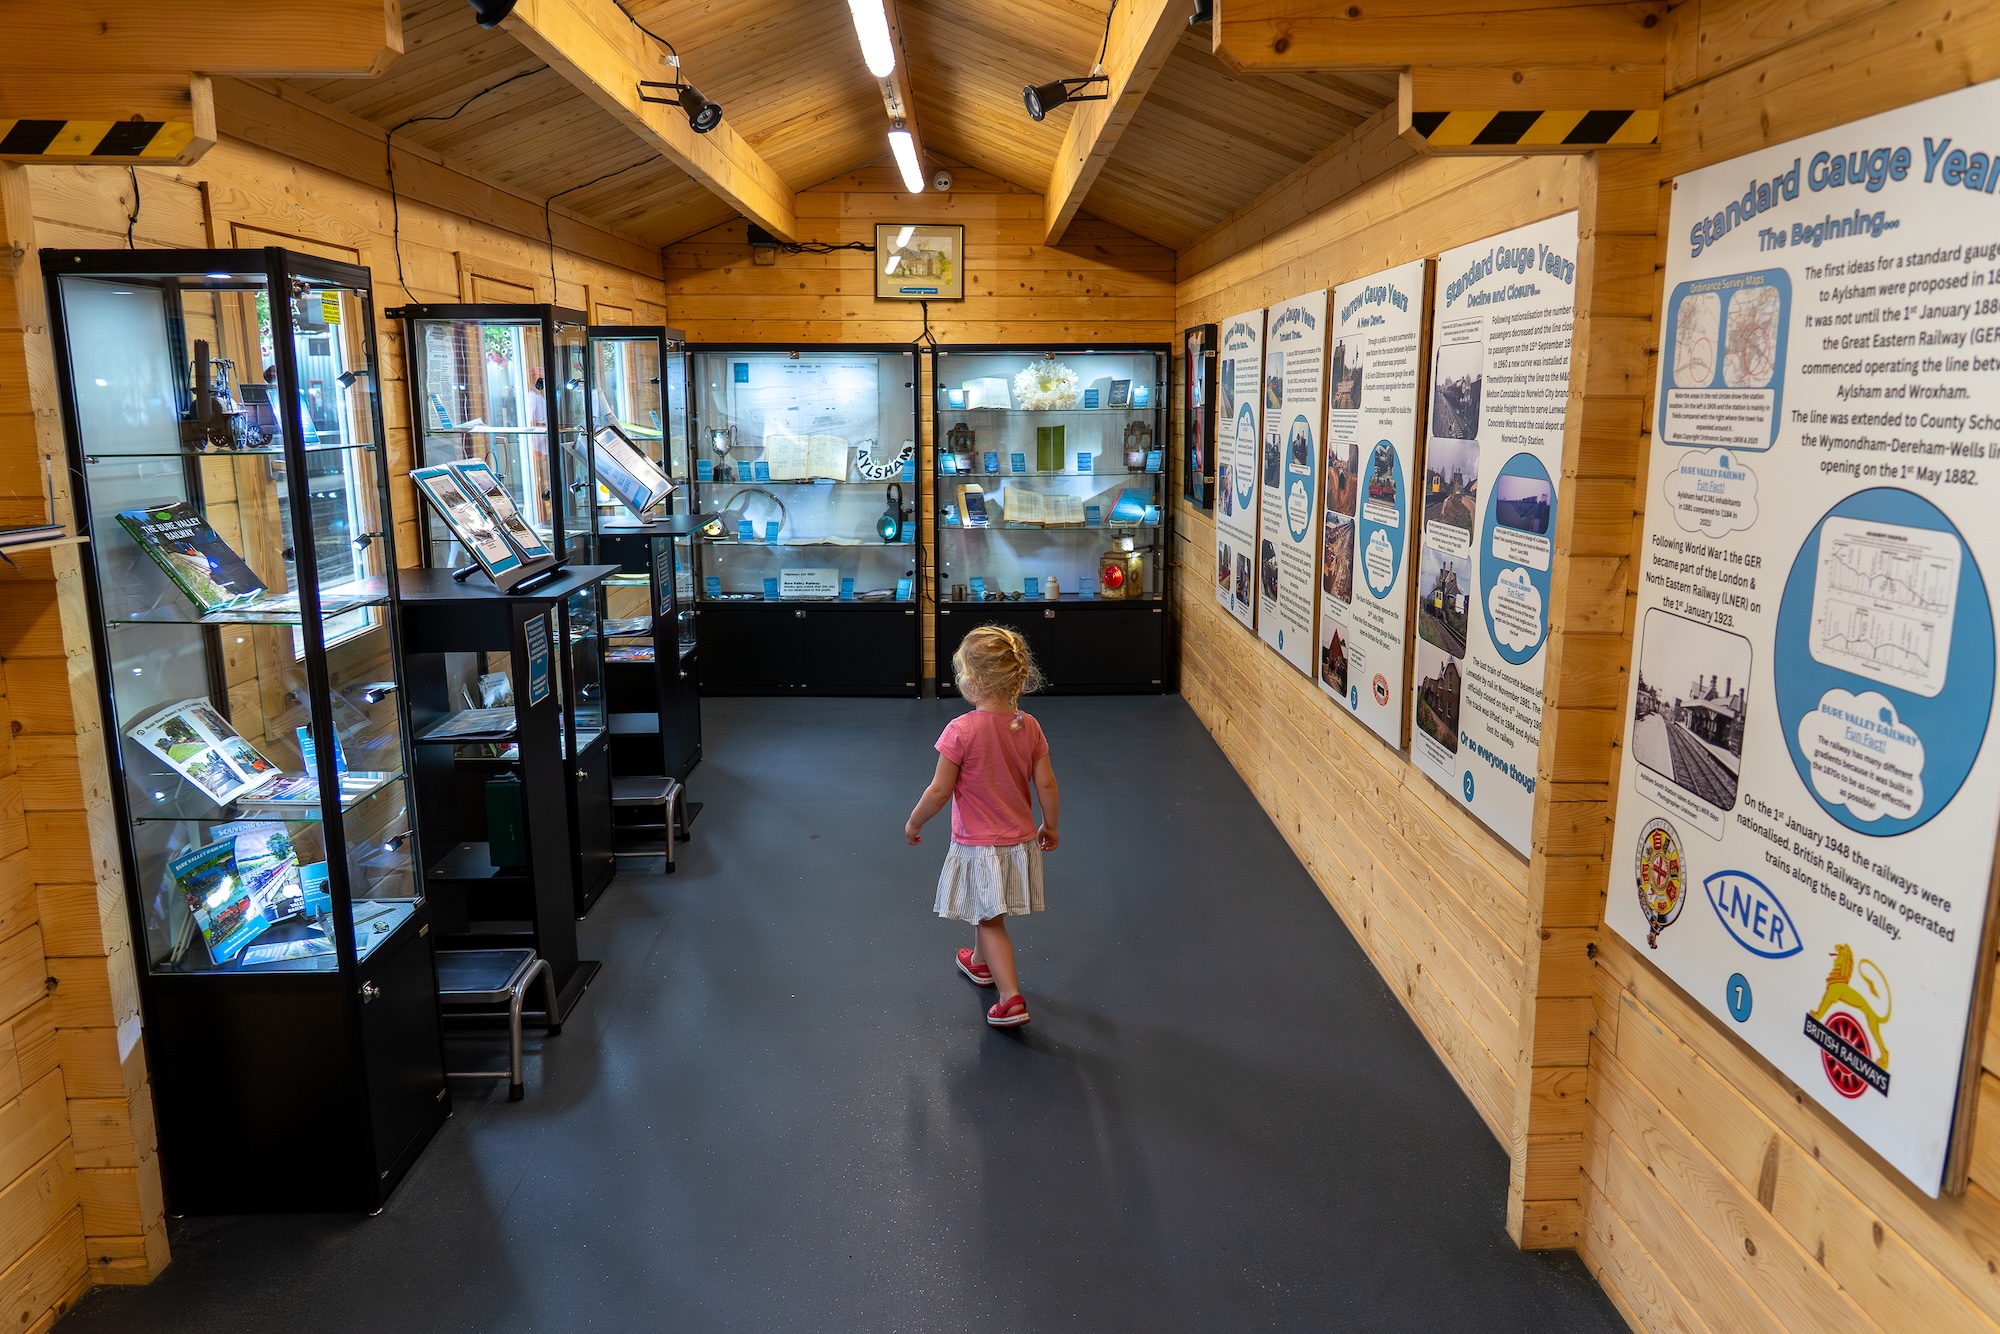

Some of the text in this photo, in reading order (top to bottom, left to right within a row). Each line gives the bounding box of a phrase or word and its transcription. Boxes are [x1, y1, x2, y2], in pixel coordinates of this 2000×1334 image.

[1690, 137, 2000, 258] Standard Gauge Year
[1759, 208, 1900, 252] The Beginning...
[1446, 244, 1575, 308] Standard Gauge Years
[1805, 266, 1822, 280] The
[1824, 263, 1844, 277] first
[1847, 260, 1874, 275] ideas
[1877, 256, 1894, 271] for
[1896, 257, 1903, 268] a
[1906, 245, 1962, 266] standard
[1467, 290, 1491, 308] Decline
[1492, 286, 1506, 303] and
[1722, 276, 1744, 290] Survey
[1746, 274, 1764, 286] Maps
[1820, 290, 1829, 302] to
[1832, 286, 1876, 303] Aylsham
[1879, 282, 1906, 295] were
[1908, 272, 1969, 296] proposed
[1972, 270, 1984, 286] in
[1342, 283, 1408, 326] Narrow Gauge Years
[1805, 299, 2000, 327] It was not until the 1st January 188
[1823, 336, 1839, 350] the
[1842, 336, 1870, 348] Great
[1873, 334, 1916, 347] Eastern
[1918, 330, 1968, 348] Railway
[1802, 359, 1862, 375] commenced
[1865, 359, 1919, 377] operating
[1922, 357, 1942, 372] the
[1946, 359, 1969, 372] line
[1837, 384, 1970, 401] Aylsham and Wroxham.
[1792, 409, 1808, 423] The
[1810, 410, 1827, 423] line
[1830, 414, 1848, 425] was
[1852, 412, 1901, 426] extended
[1905, 414, 1917, 427] to
[1920, 414, 1966, 433] County
[858, 447, 912, 478] AYLSHAM
[1801, 434, 1817, 447] the
[1820, 434, 1985, 459] Wymondham-Dereham-Wells
[1820, 460, 1979, 486] opening on the 1st May 1882.
[141, 525, 159, 533] THE
[157, 522, 178, 532] BURE
[174, 517, 201, 527] VALLEY
[164, 529, 195, 540] RAILWAY
[1652, 535, 1761, 568] Following World War 1 the GER
[1653, 554, 1756, 590] became part of the London &
[1646, 572, 1761, 613] North Eastern Railway (LNER) on
[1663, 596, 1674, 608] the
[1684, 603, 1713, 623] January
[1715, 611, 1734, 628] 1923.
[1822, 704, 1918, 747] BURE VALLEY RAILWAY
[1845, 726, 1886, 754] Fun Fact!
[1461, 731, 1468, 745] Or
[1469, 738, 1476, 752] so
[1478, 745, 1508, 774] everyone
[1467, 778, 1472, 794] 2
[218, 823, 255, 836] SOUVENIR
[1744, 794, 1952, 912] On the 1st January 1948 the railways were
[1737, 813, 1955, 943] nationalised. British Railways now operated
[1765, 850, 1902, 940] trains along the Bure Valley.
[1718, 880, 1784, 950] LNER
[1735, 985, 1743, 1011] 1
[1806, 1021, 1887, 1090] BRITISH RAILWAYS
